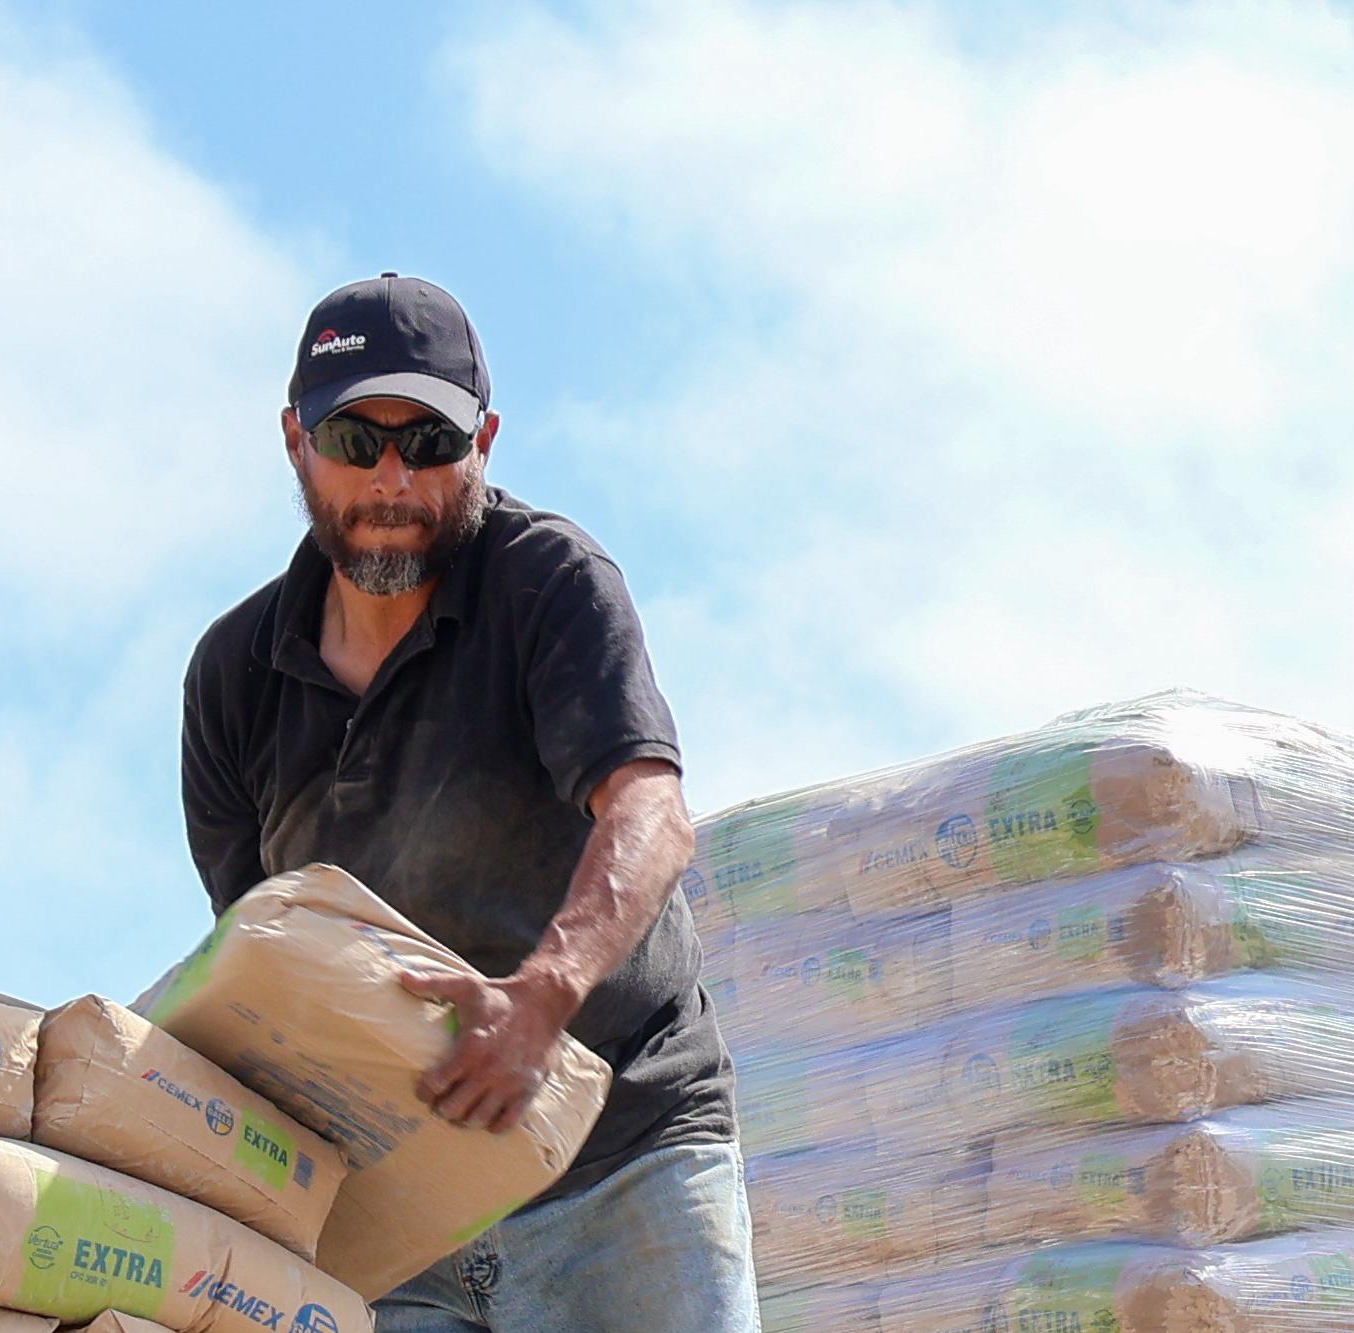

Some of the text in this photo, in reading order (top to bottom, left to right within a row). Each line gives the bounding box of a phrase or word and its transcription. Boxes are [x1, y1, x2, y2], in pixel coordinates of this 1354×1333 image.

[310, 334, 366, 357] SunAuto
[157, 1076, 288, 1169] CEMEX EXTRA
[72, 1239, 164, 1290] EXTRA
[206, 1279, 287, 1333] CEMEX
